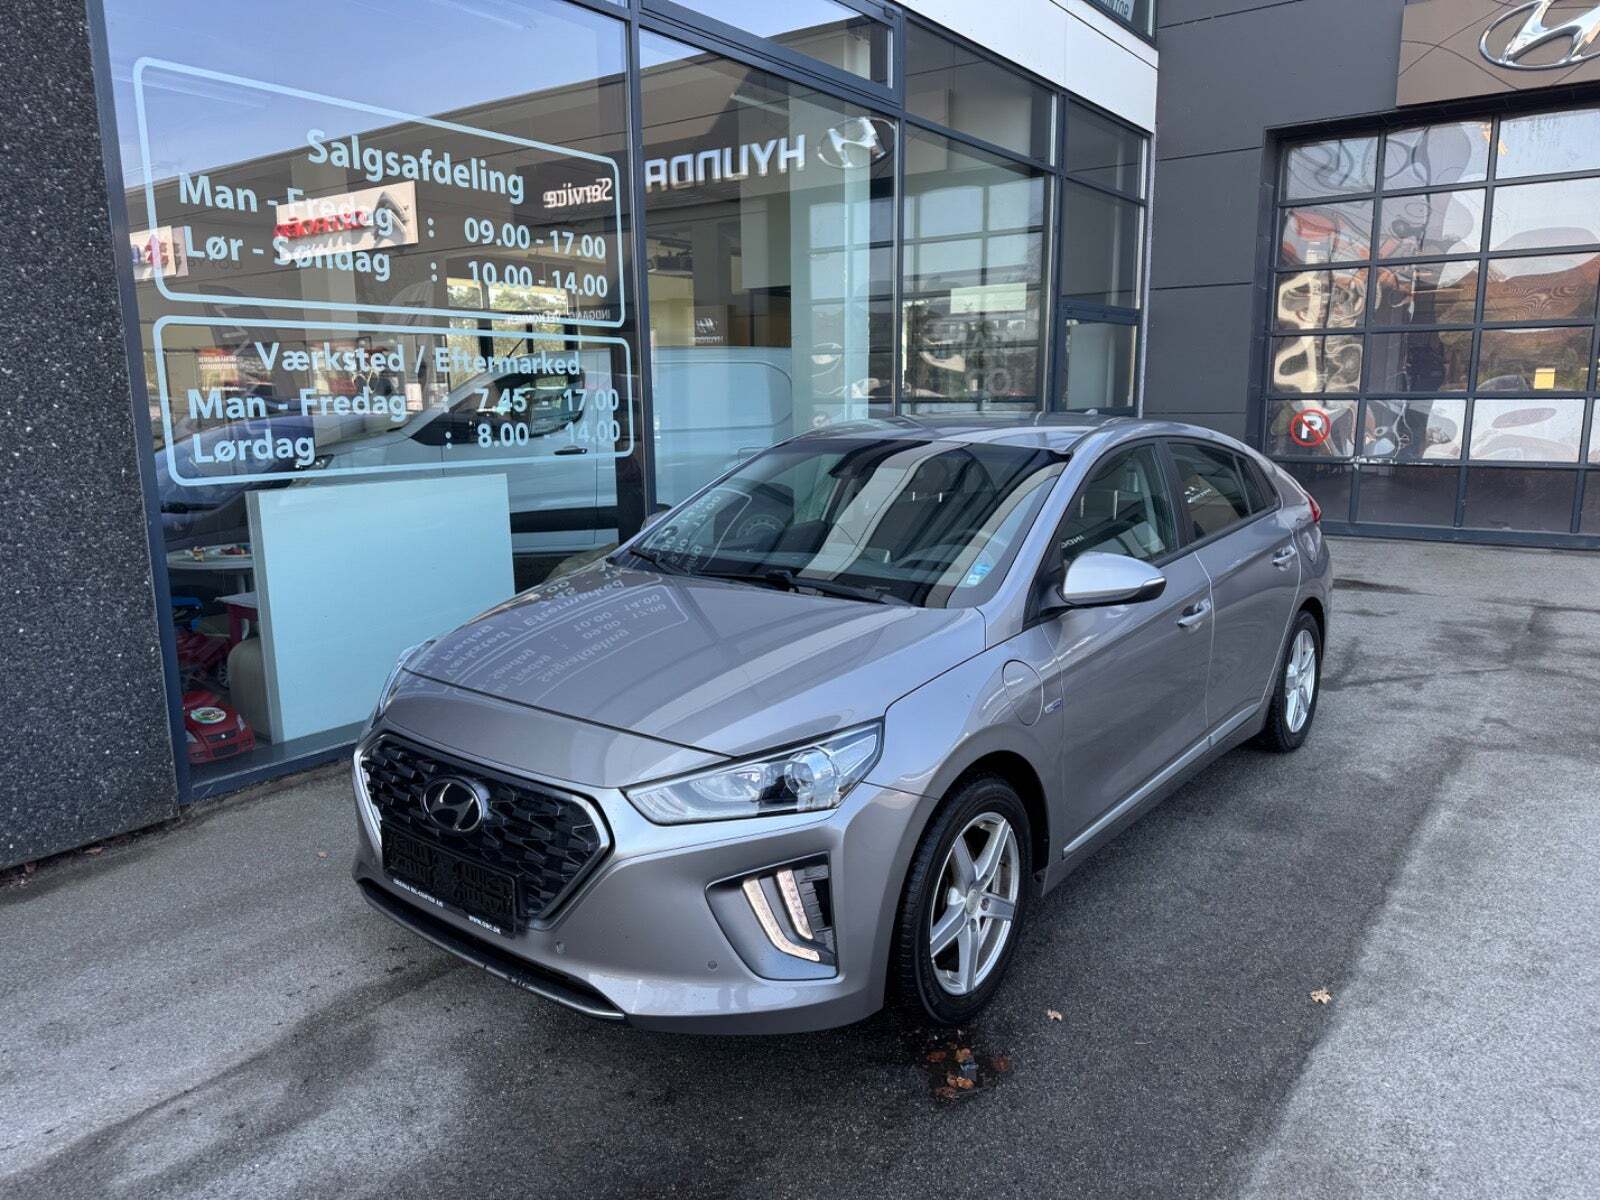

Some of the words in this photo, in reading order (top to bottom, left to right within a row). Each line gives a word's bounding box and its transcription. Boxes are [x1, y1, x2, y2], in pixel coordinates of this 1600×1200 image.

[306, 128, 525, 205] Salgsafdeling
[179, 172, 258, 213] Man
[287, 187, 394, 237] Fredag
[464, 217, 531, 250] 09.00
[549, 230, 606, 260] 17.00
[184, 225, 243, 262] Lør
[272, 235, 391, 282] Søndag
[468, 260, 533, 289] 10.00
[552, 269, 608, 298] 14.00
[254, 342, 404, 373] Værksted
[415, 345, 426, 375] /
[434, 347, 581, 375] Eftermarked
[187, 388, 267, 420] Man
[300, 386, 407, 422] Fredag
[474, 388, 528, 413] 7.45
[563, 388, 620, 412] 17.00
[192, 429, 316, 466] Lørdag
[477, 422, 530, 449] 8.00
[565, 420, 621, 443] 14.00
